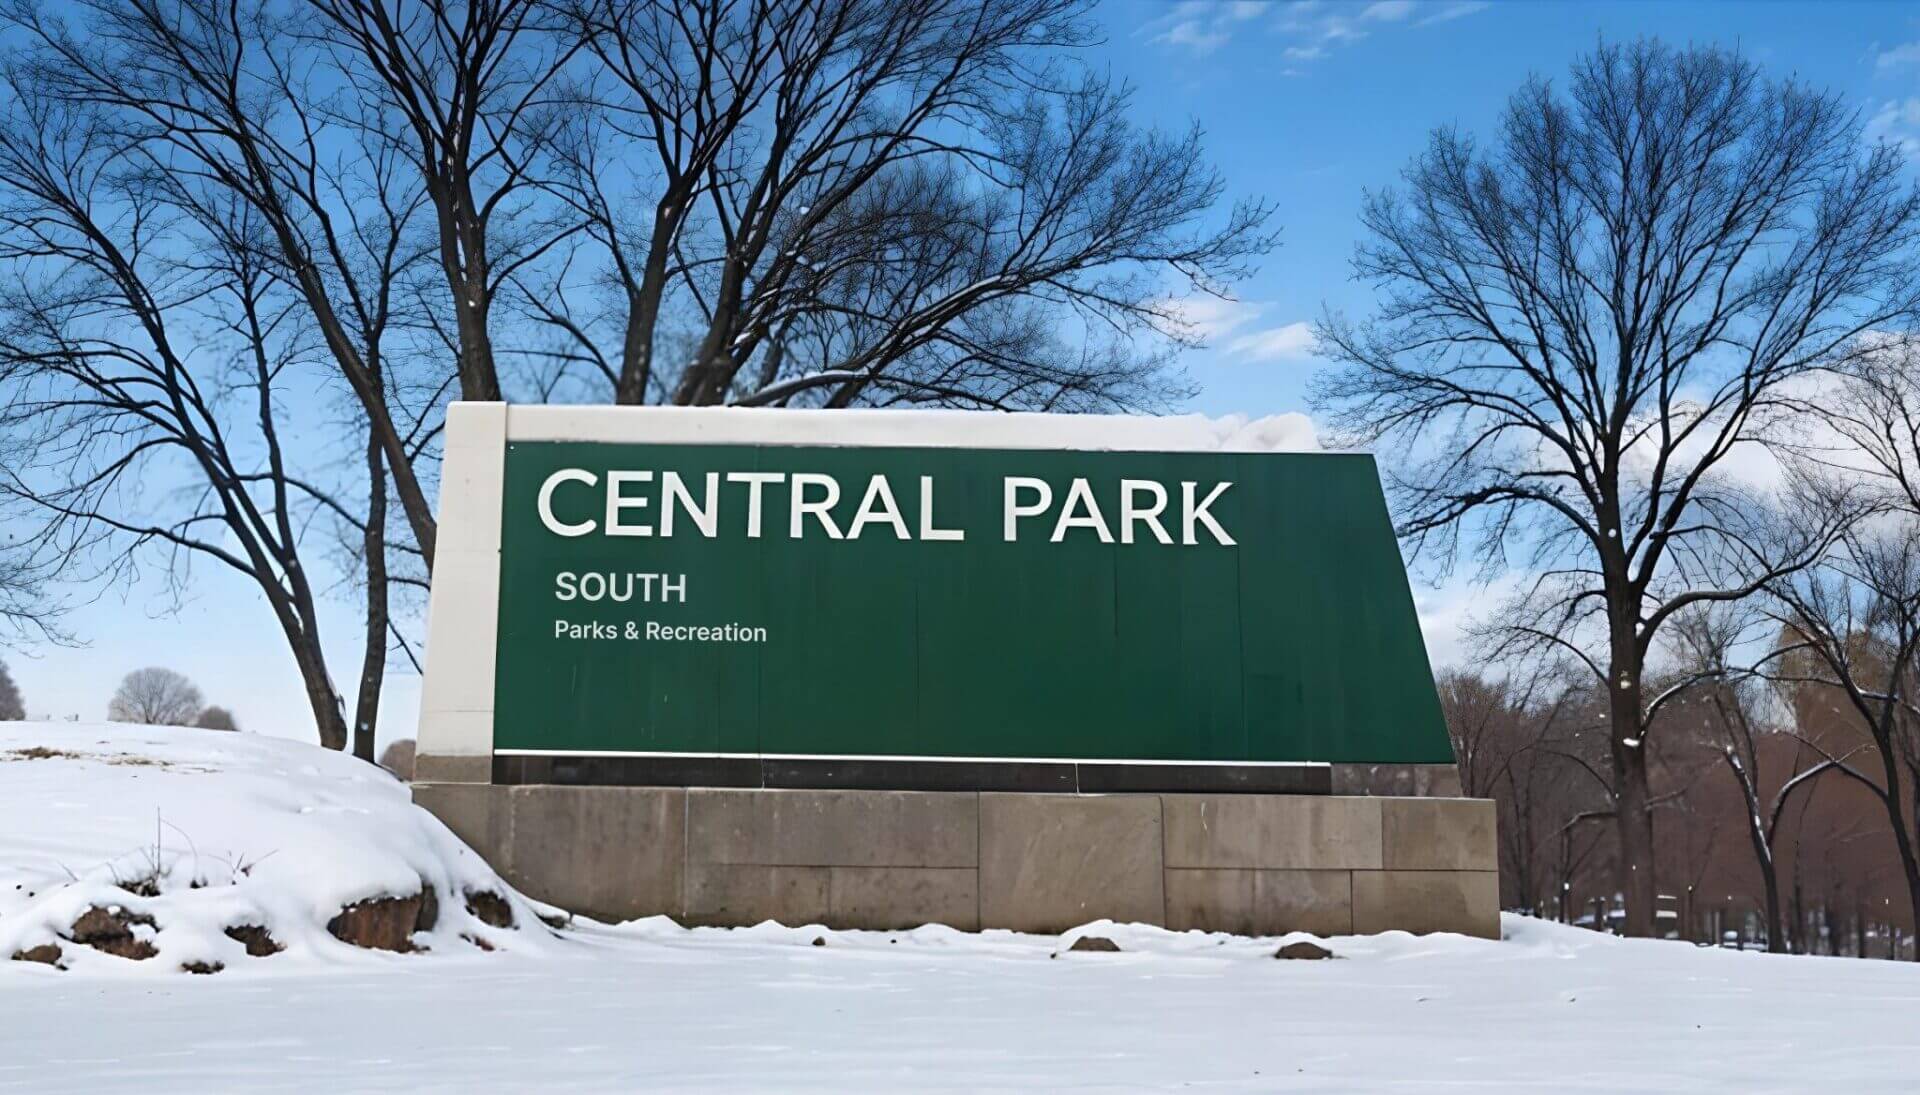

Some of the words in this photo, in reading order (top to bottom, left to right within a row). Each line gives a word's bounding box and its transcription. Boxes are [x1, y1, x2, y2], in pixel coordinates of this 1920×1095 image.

[537, 468, 965, 541] CENTRAL
[1003, 476, 1238, 546] PARK
[555, 571, 687, 603] SOUTH
[554, 620, 618, 640] Parks
[624, 621, 639, 641] &
[645, 621, 767, 642] Recreation
